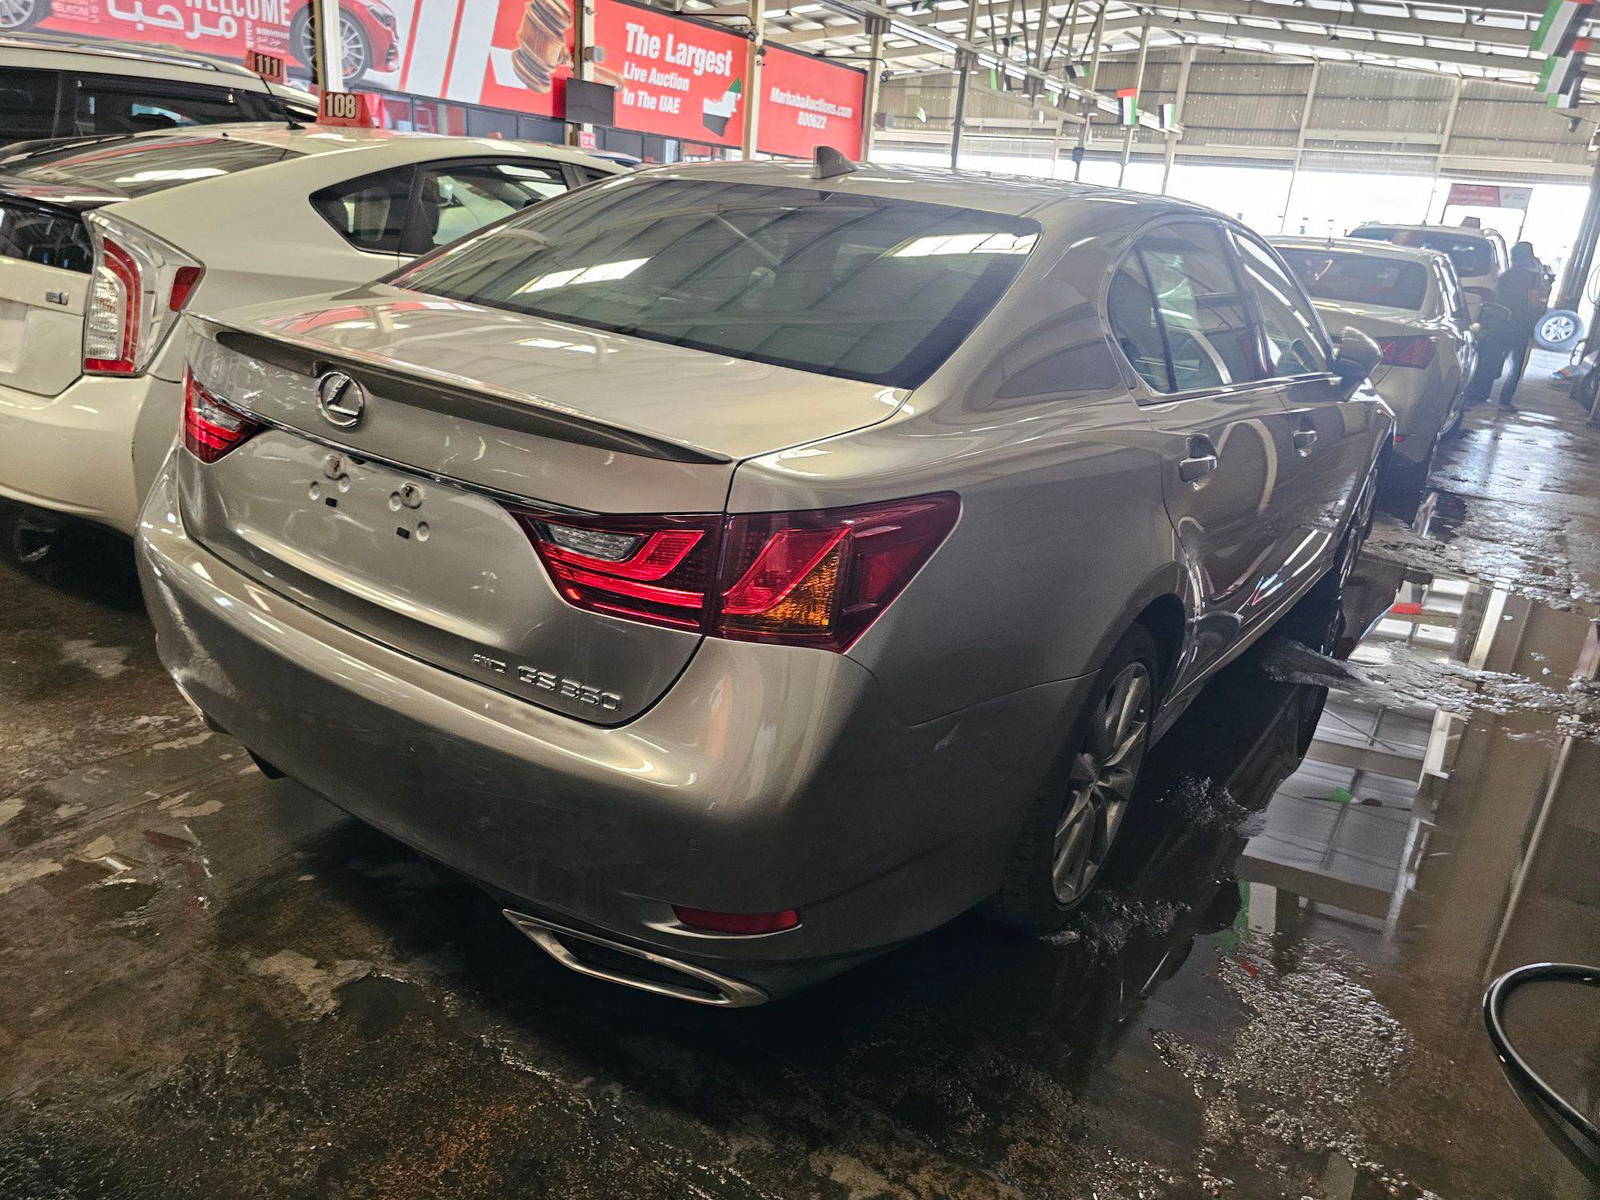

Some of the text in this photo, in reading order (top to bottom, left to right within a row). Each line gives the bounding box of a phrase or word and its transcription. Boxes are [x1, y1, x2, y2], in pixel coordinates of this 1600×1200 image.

[625, 22, 732, 77] The Largest
[255, 54, 280, 77] 111
[623, 61, 690, 91] Live Auction
[325, 93, 357, 119] 108
[622, 87, 681, 115] In The UAE
[517, 664, 558, 691] GS
[561, 677, 622, 712] 350
